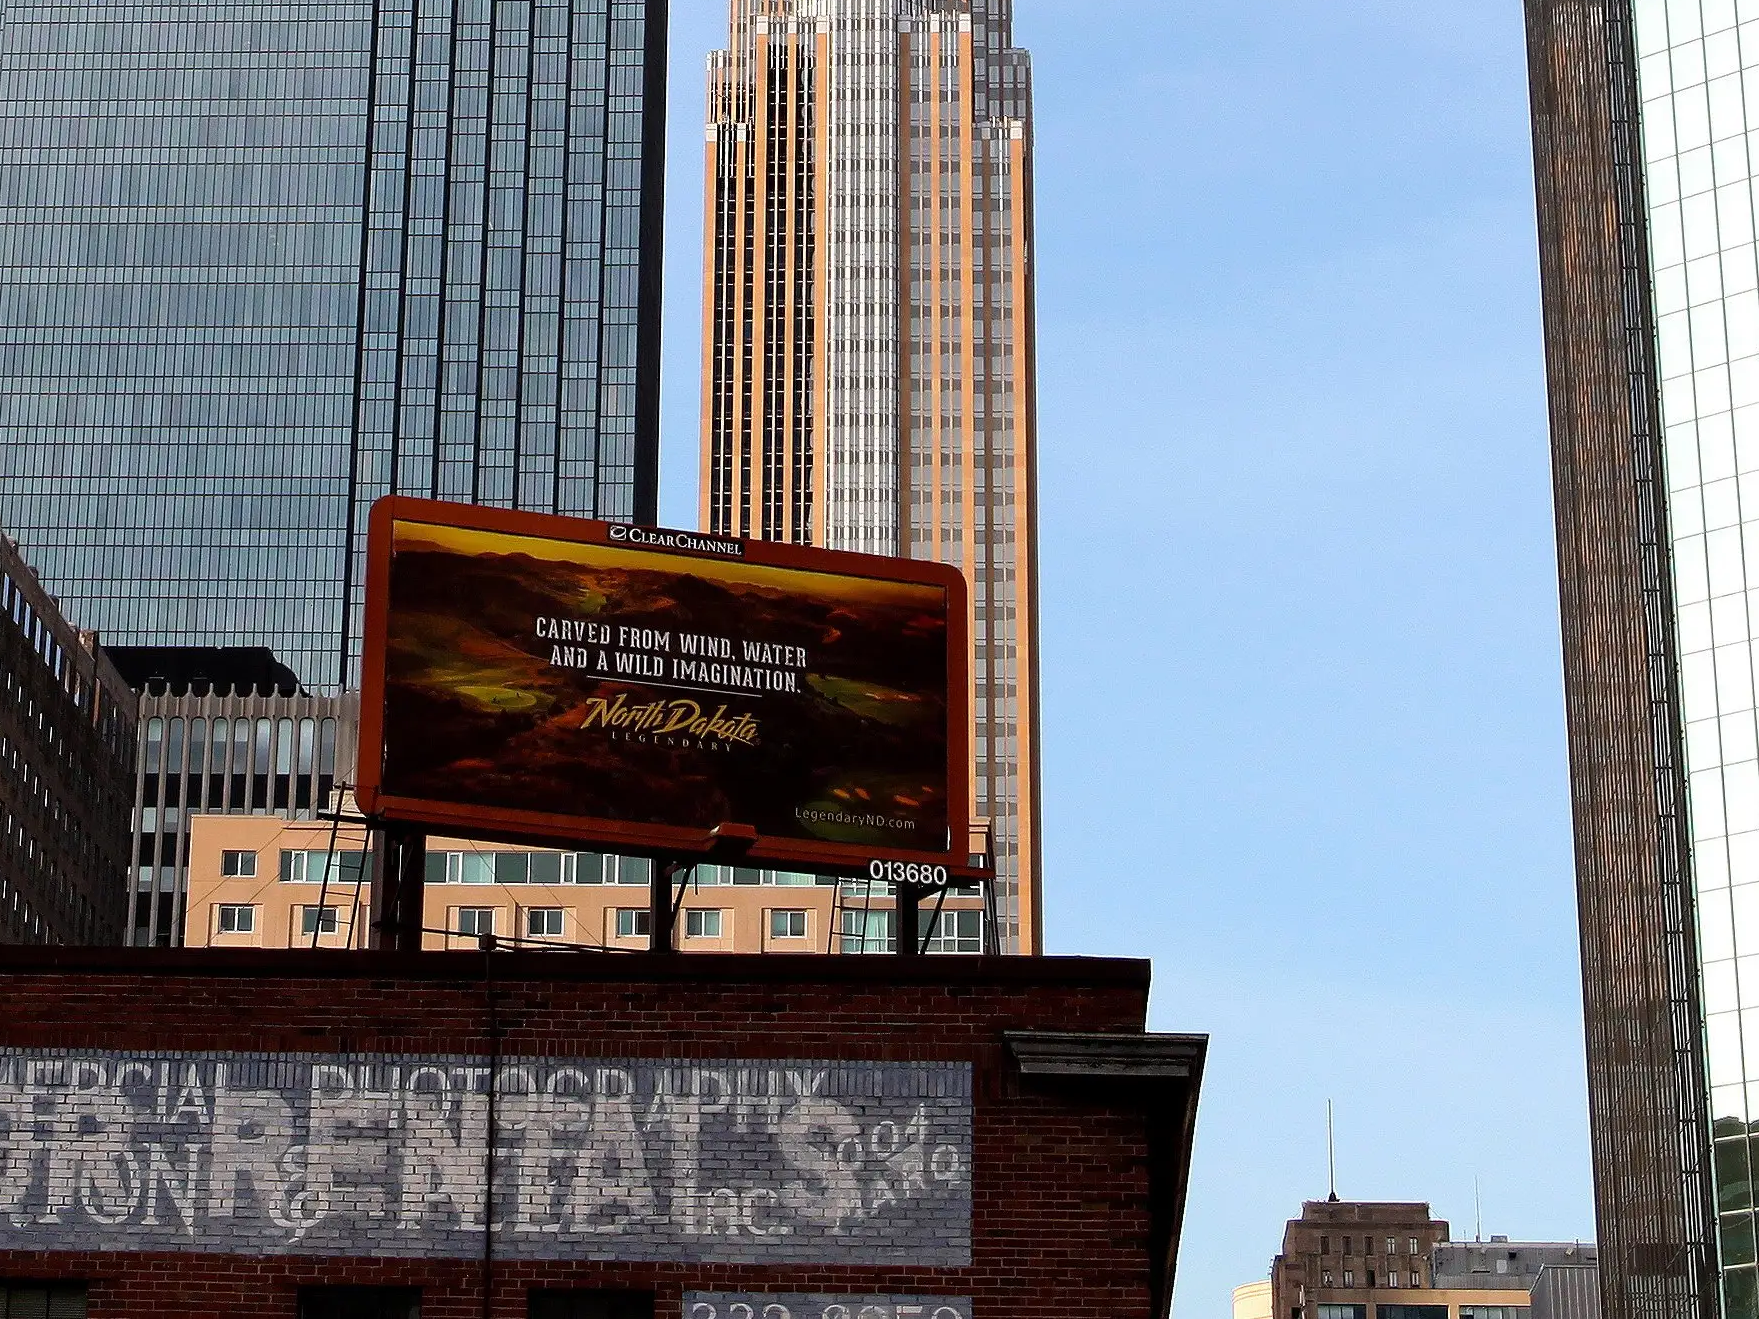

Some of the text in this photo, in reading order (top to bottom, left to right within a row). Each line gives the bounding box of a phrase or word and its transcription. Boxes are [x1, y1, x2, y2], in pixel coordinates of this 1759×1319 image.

[536, 616, 807, 668] CARVED FROM WIND, WATER
[549, 645, 802, 694] AND A WILD IMAGINATION.
[580, 693, 666, 732] North
[611, 731, 732, 752] LEGENDARY
[795, 807, 915, 830] LegendaryND.com
[869, 859, 947, 885] 013680
